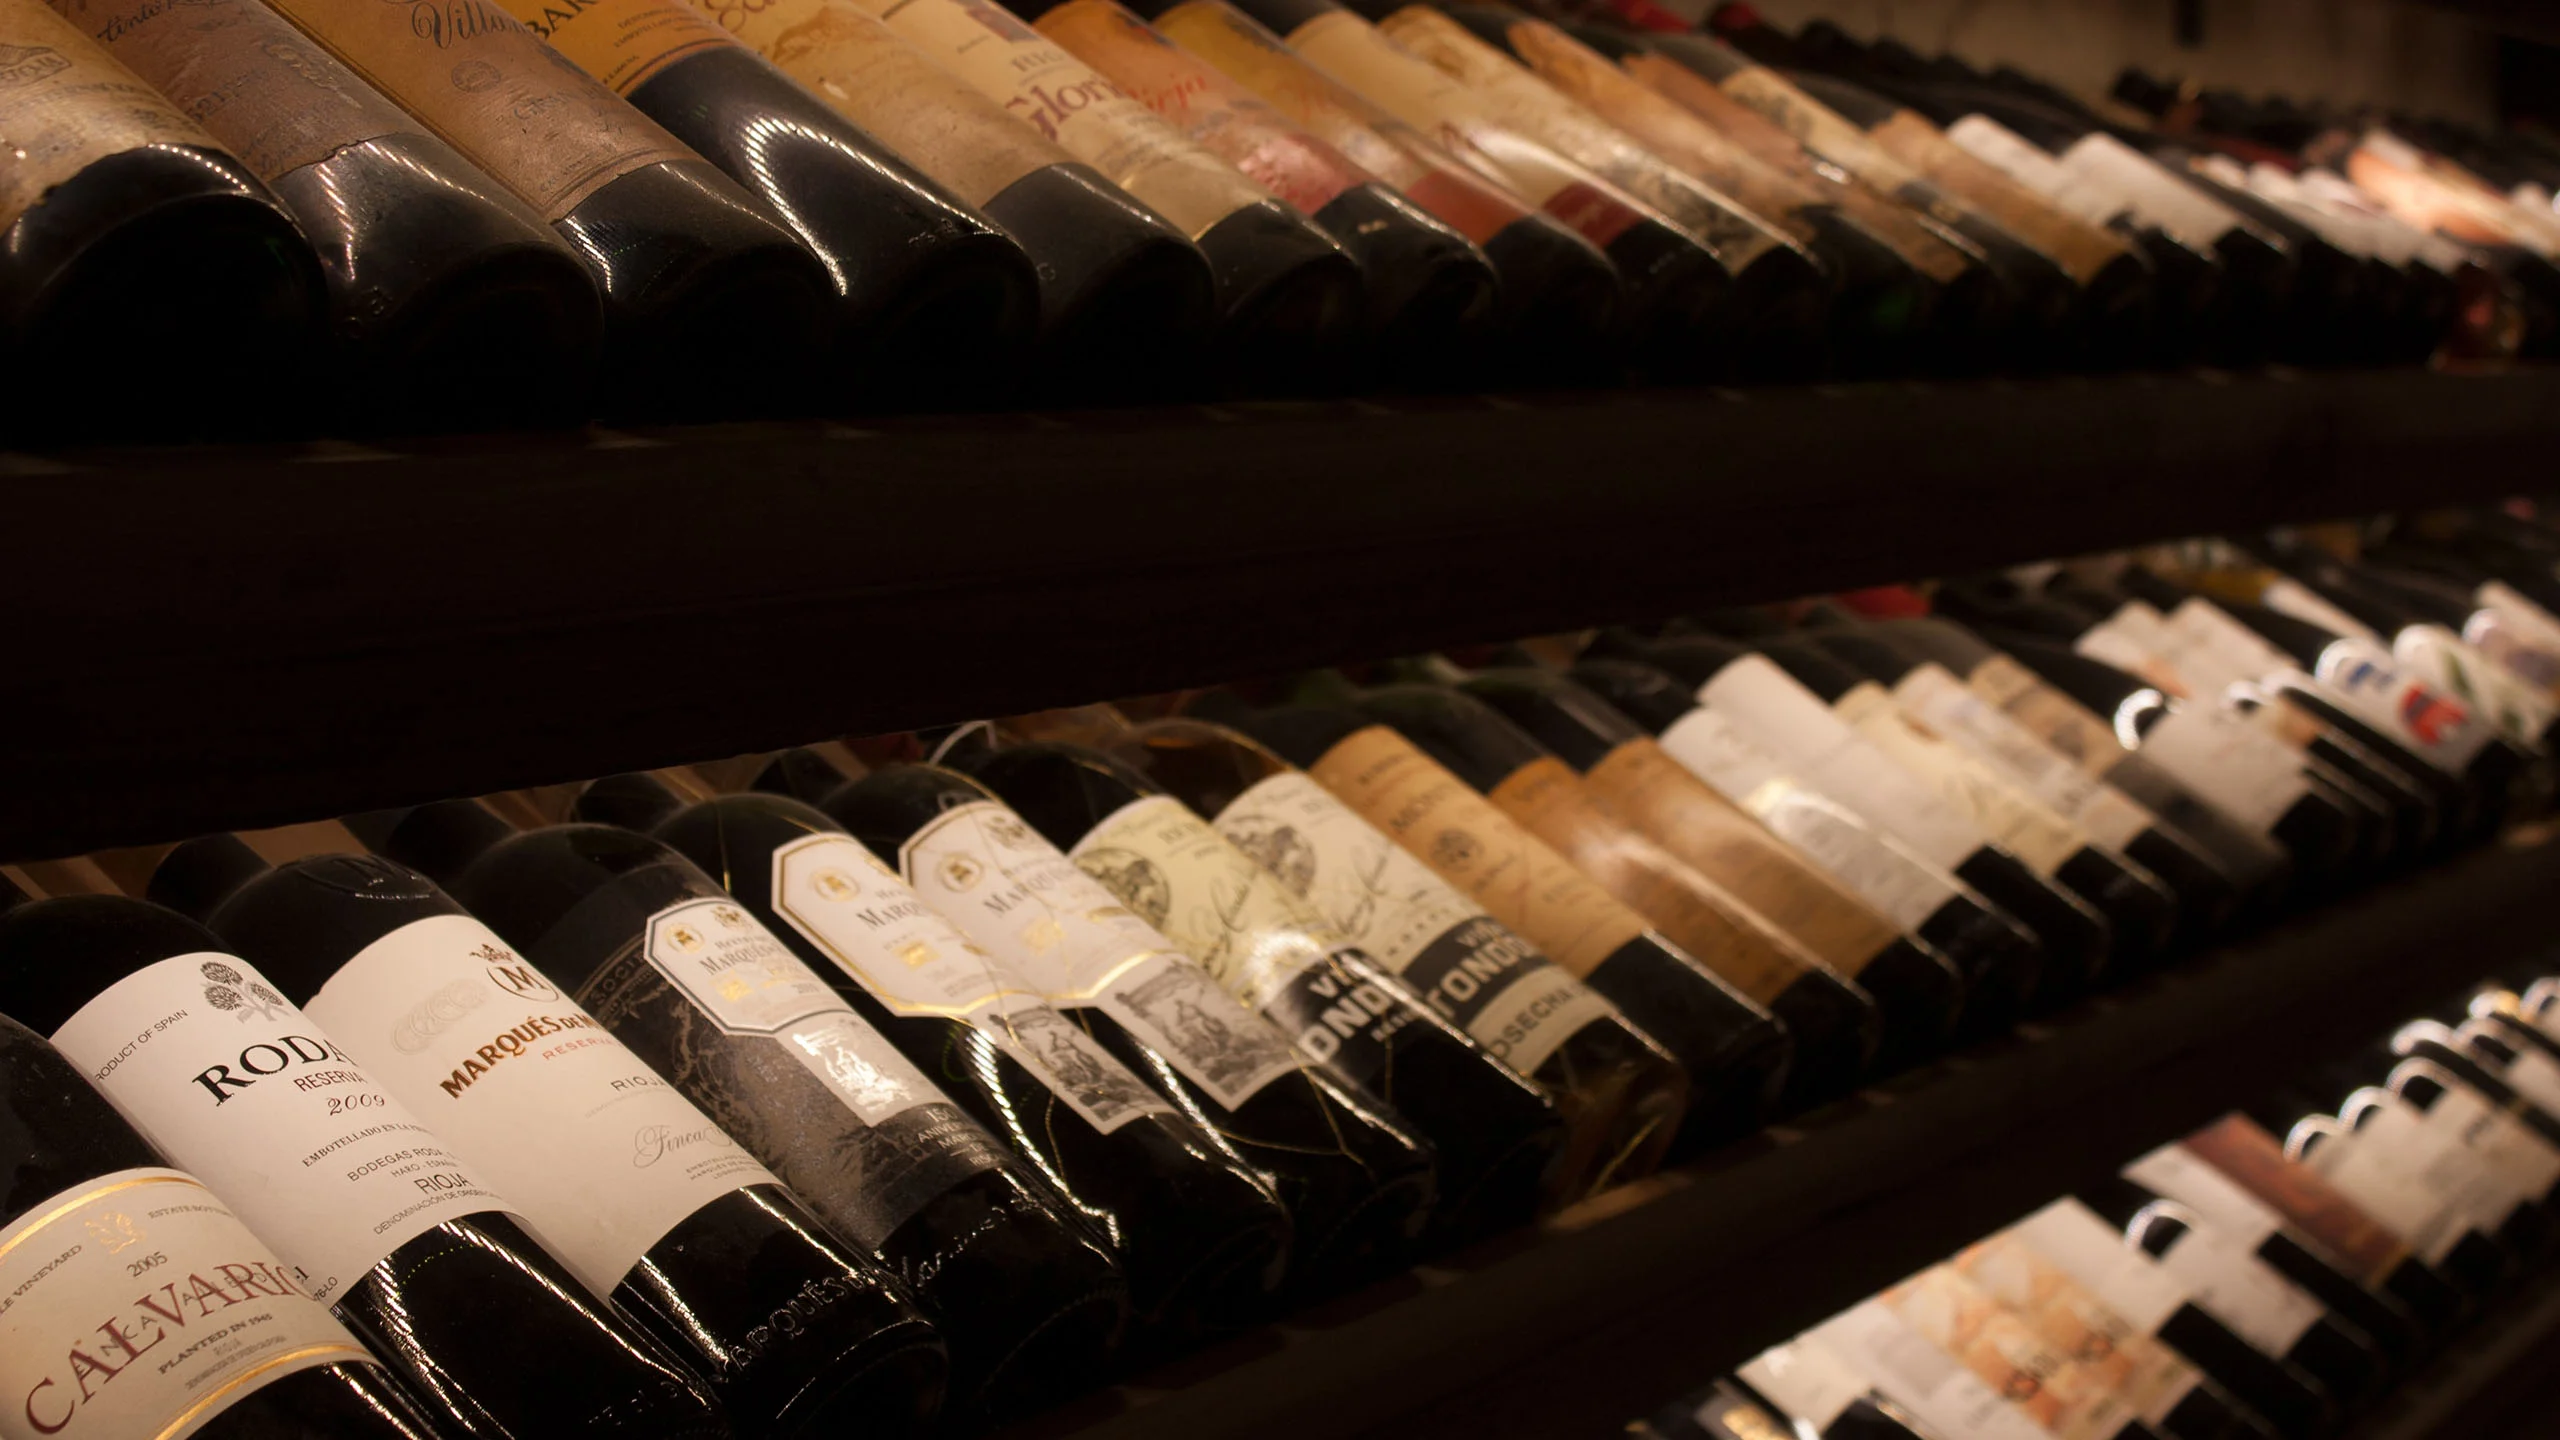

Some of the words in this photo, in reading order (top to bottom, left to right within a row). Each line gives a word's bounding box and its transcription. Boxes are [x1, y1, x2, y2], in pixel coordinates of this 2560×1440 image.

[95, 1041, 138, 1081] RODUCT
[137, 1029, 154, 1045] OF
[153, 1008, 189, 1033] SPAIN
[1489, 986, 1576, 1061] OSECHA
[191, 1034, 359, 1107] RODA
[439, 1015, 562, 1100] MARQUÉS
[293, 1070, 369, 1093] RESERVA
[326, 1094, 386, 1117] 2009
[301, 1125, 382, 1168] EMBOTELLADO
[347, 1149, 412, 1182] BODEGAS
[390, 1162, 421, 1178] HARO
[413, 1172, 474, 1195] RIOJA
[14, 1244, 82, 1297] VINEYARD
[126, 1250, 168, 1278] 2005
[157, 1329, 229, 1375] PLANTED
[229, 1319, 248, 1334] IN
